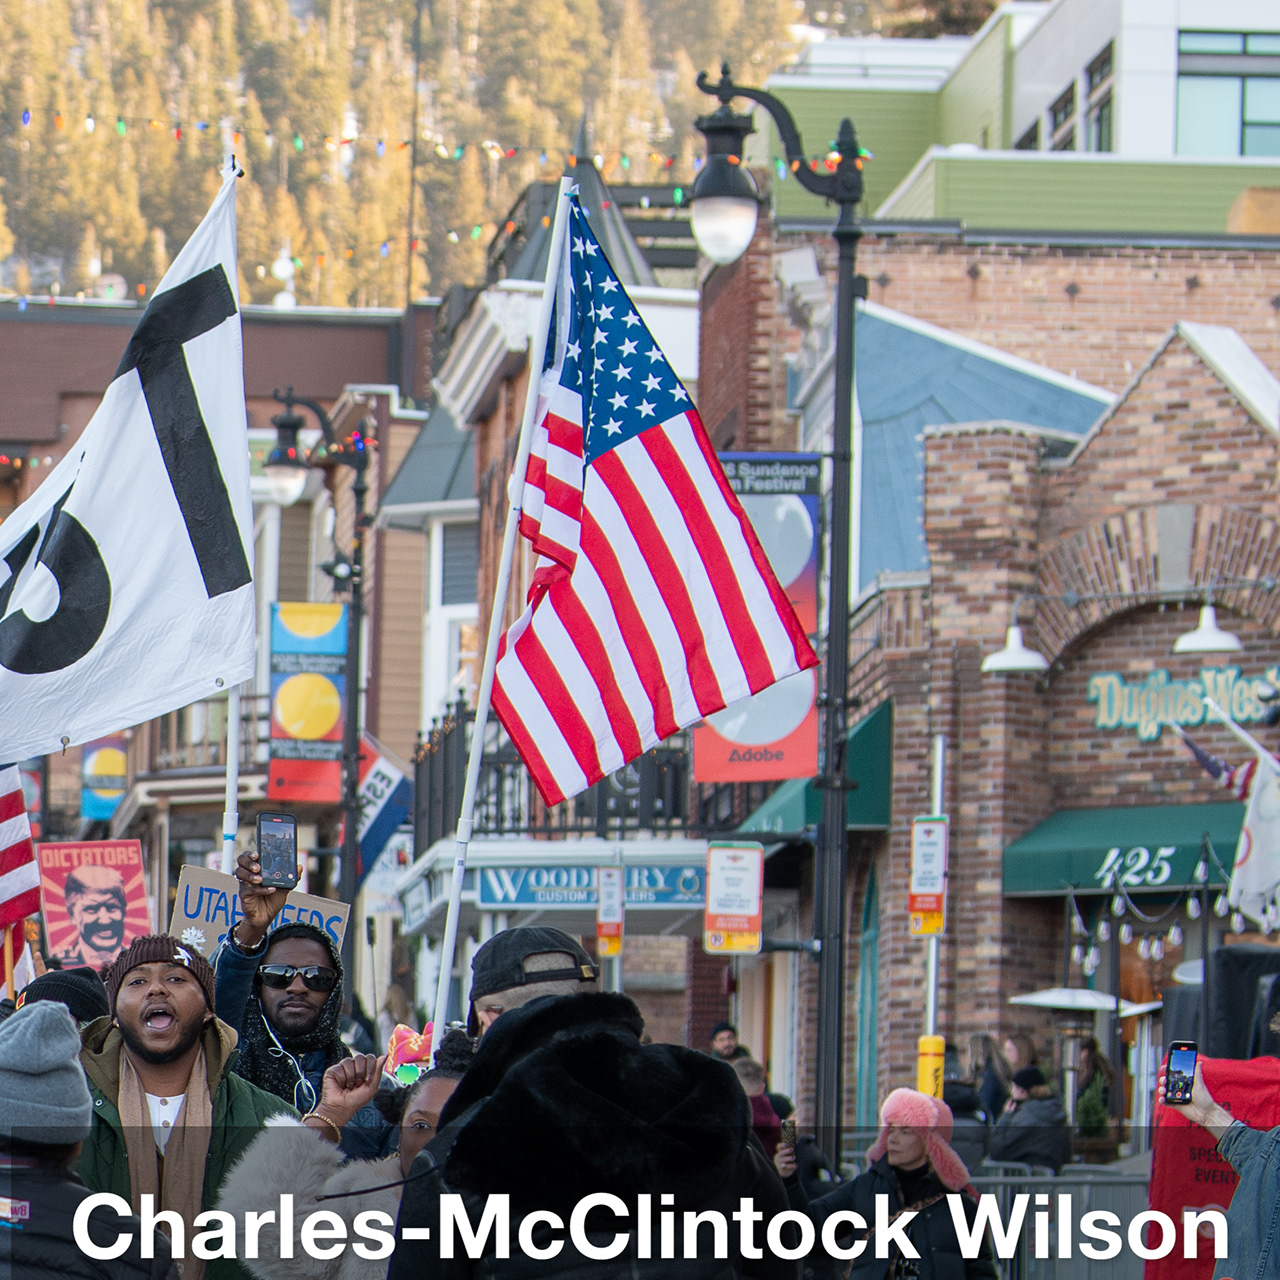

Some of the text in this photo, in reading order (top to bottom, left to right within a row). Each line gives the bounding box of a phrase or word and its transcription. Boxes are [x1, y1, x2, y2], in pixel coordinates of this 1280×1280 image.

[738, 460, 819, 478] Sundance
[746, 475, 807, 491] Festival
[728, 748, 785, 763] Adobe
[41, 847, 139, 868] DICTATORS
[1094, 846, 1177, 889] 425
[534, 890, 587, 902] CUSTOM
[1195, 1168, 1239, 1184] EVENT
